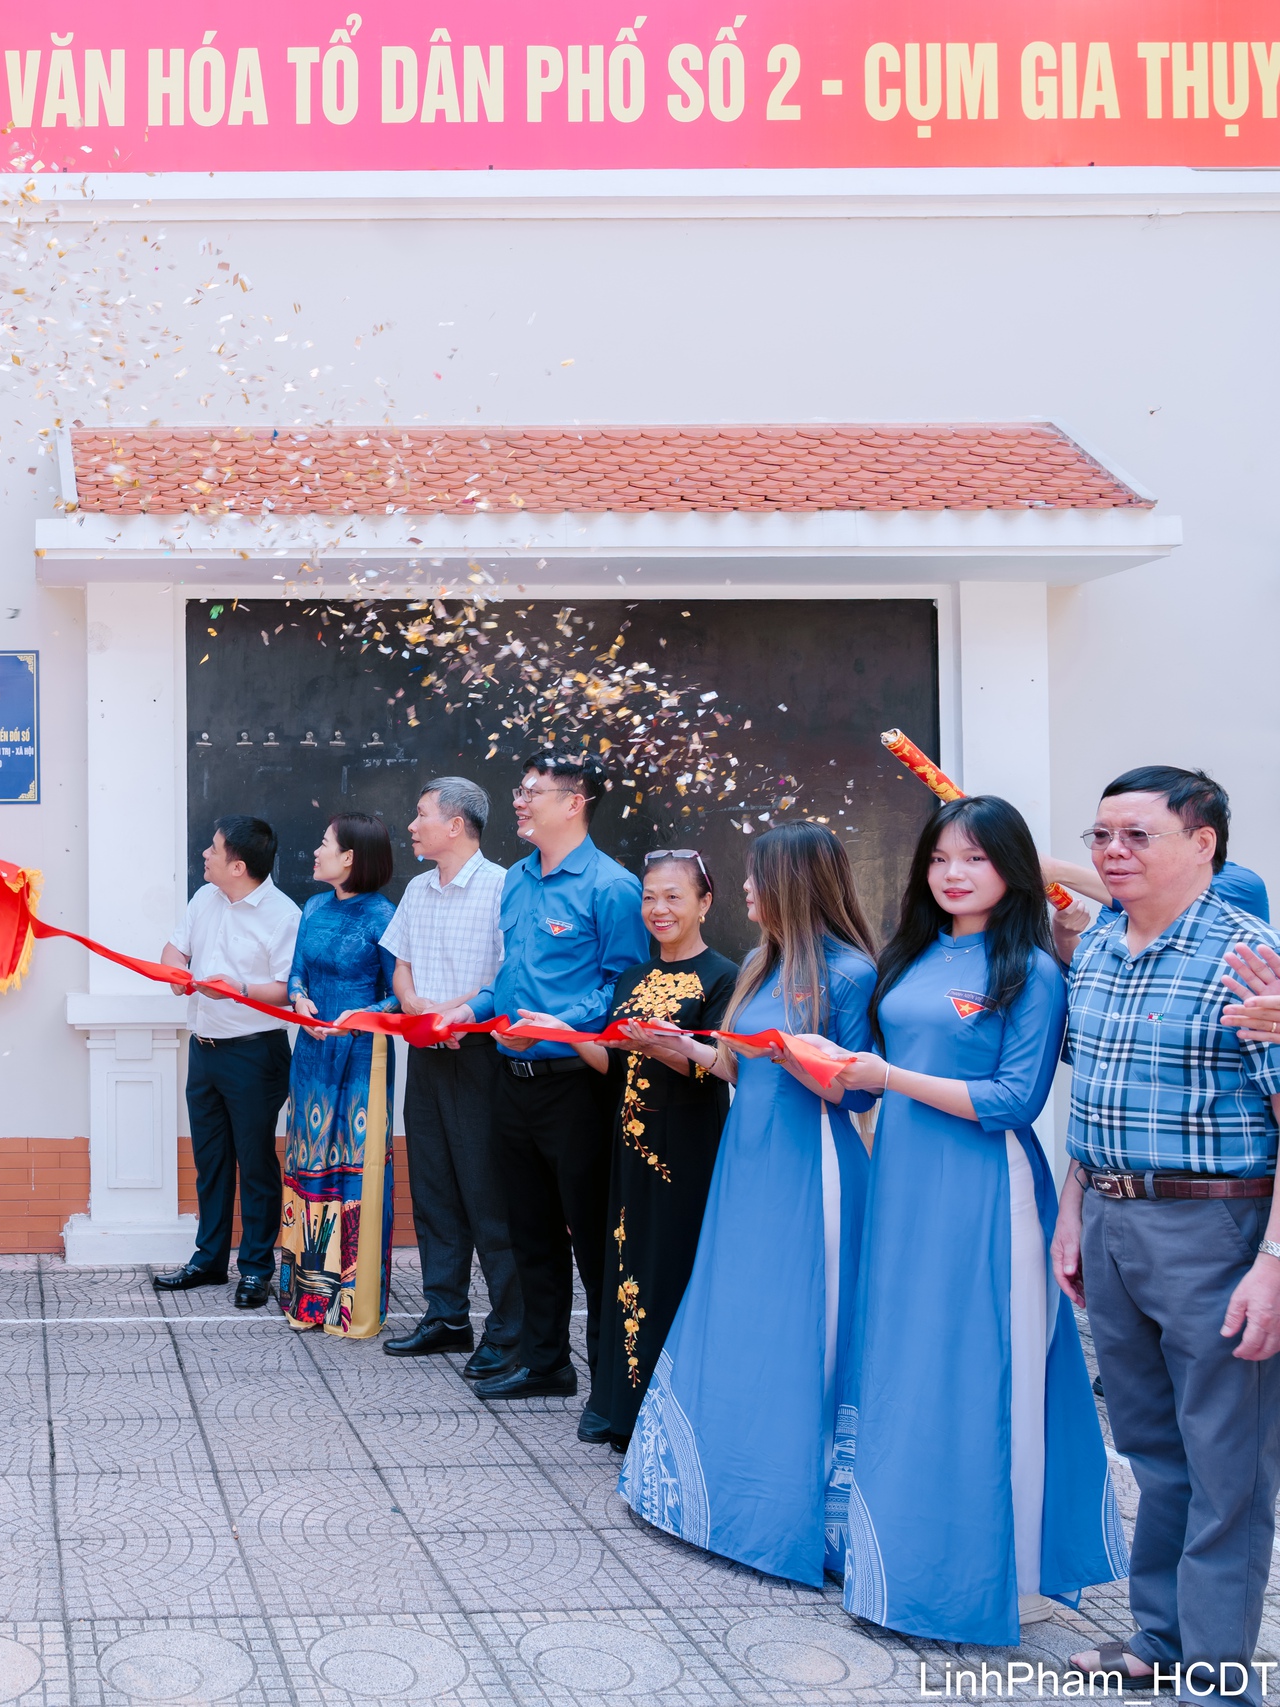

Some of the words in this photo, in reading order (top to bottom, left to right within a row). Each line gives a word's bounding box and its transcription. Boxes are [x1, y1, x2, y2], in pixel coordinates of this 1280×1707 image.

[5, 32, 125, 128] VĂN
[147, 31, 269, 127] HÓA
[287, 13, 363, 126] TỔ
[381, 28, 504, 124] DÂN
[526, 16, 647, 123] PHỐ
[667, 15, 747, 123] SỐ
[766, 44, 801, 121] 2
[822, 80, 843, 95] -
[864, 41, 1000, 138] CỤM
[1020, 41, 1121, 120] GIA
[1137, 41, 1280, 137] THỤY
[10, 726, 20, 742] ĐỔI
[21, 726, 30, 742] SỐ
[2, 747, 10, 757] TRỊ
